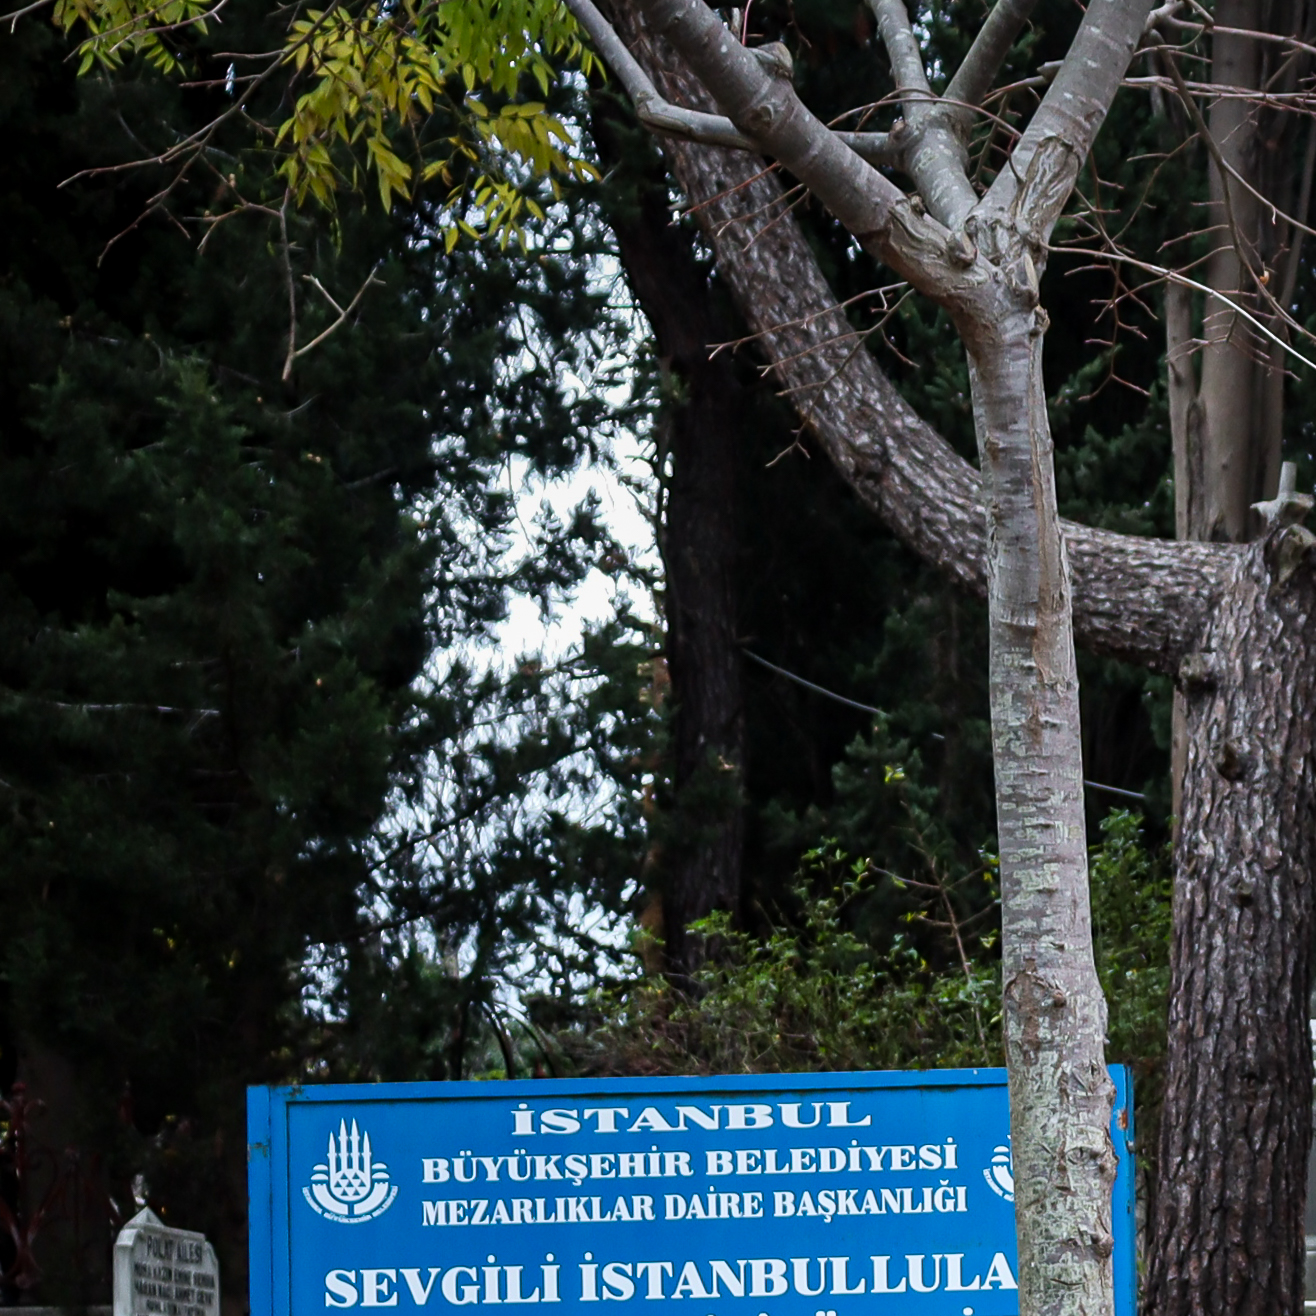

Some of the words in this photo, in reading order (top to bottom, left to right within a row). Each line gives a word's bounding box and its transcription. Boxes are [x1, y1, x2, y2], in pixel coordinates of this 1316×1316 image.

[510, 1101, 872, 1135] İSTANBUL
[421, 1145, 694, 1187] BÜYÜKŞEHİR
[705, 1136, 958, 1178] BELEDİYESİ
[421, 1192, 656, 1226] MEZARLIKLAR
[664, 1186, 764, 1220] DAİRE
[773, 1179, 968, 1223] BAŞKANLIĞI
[325, 1252, 562, 1308] SEVGİLİ
